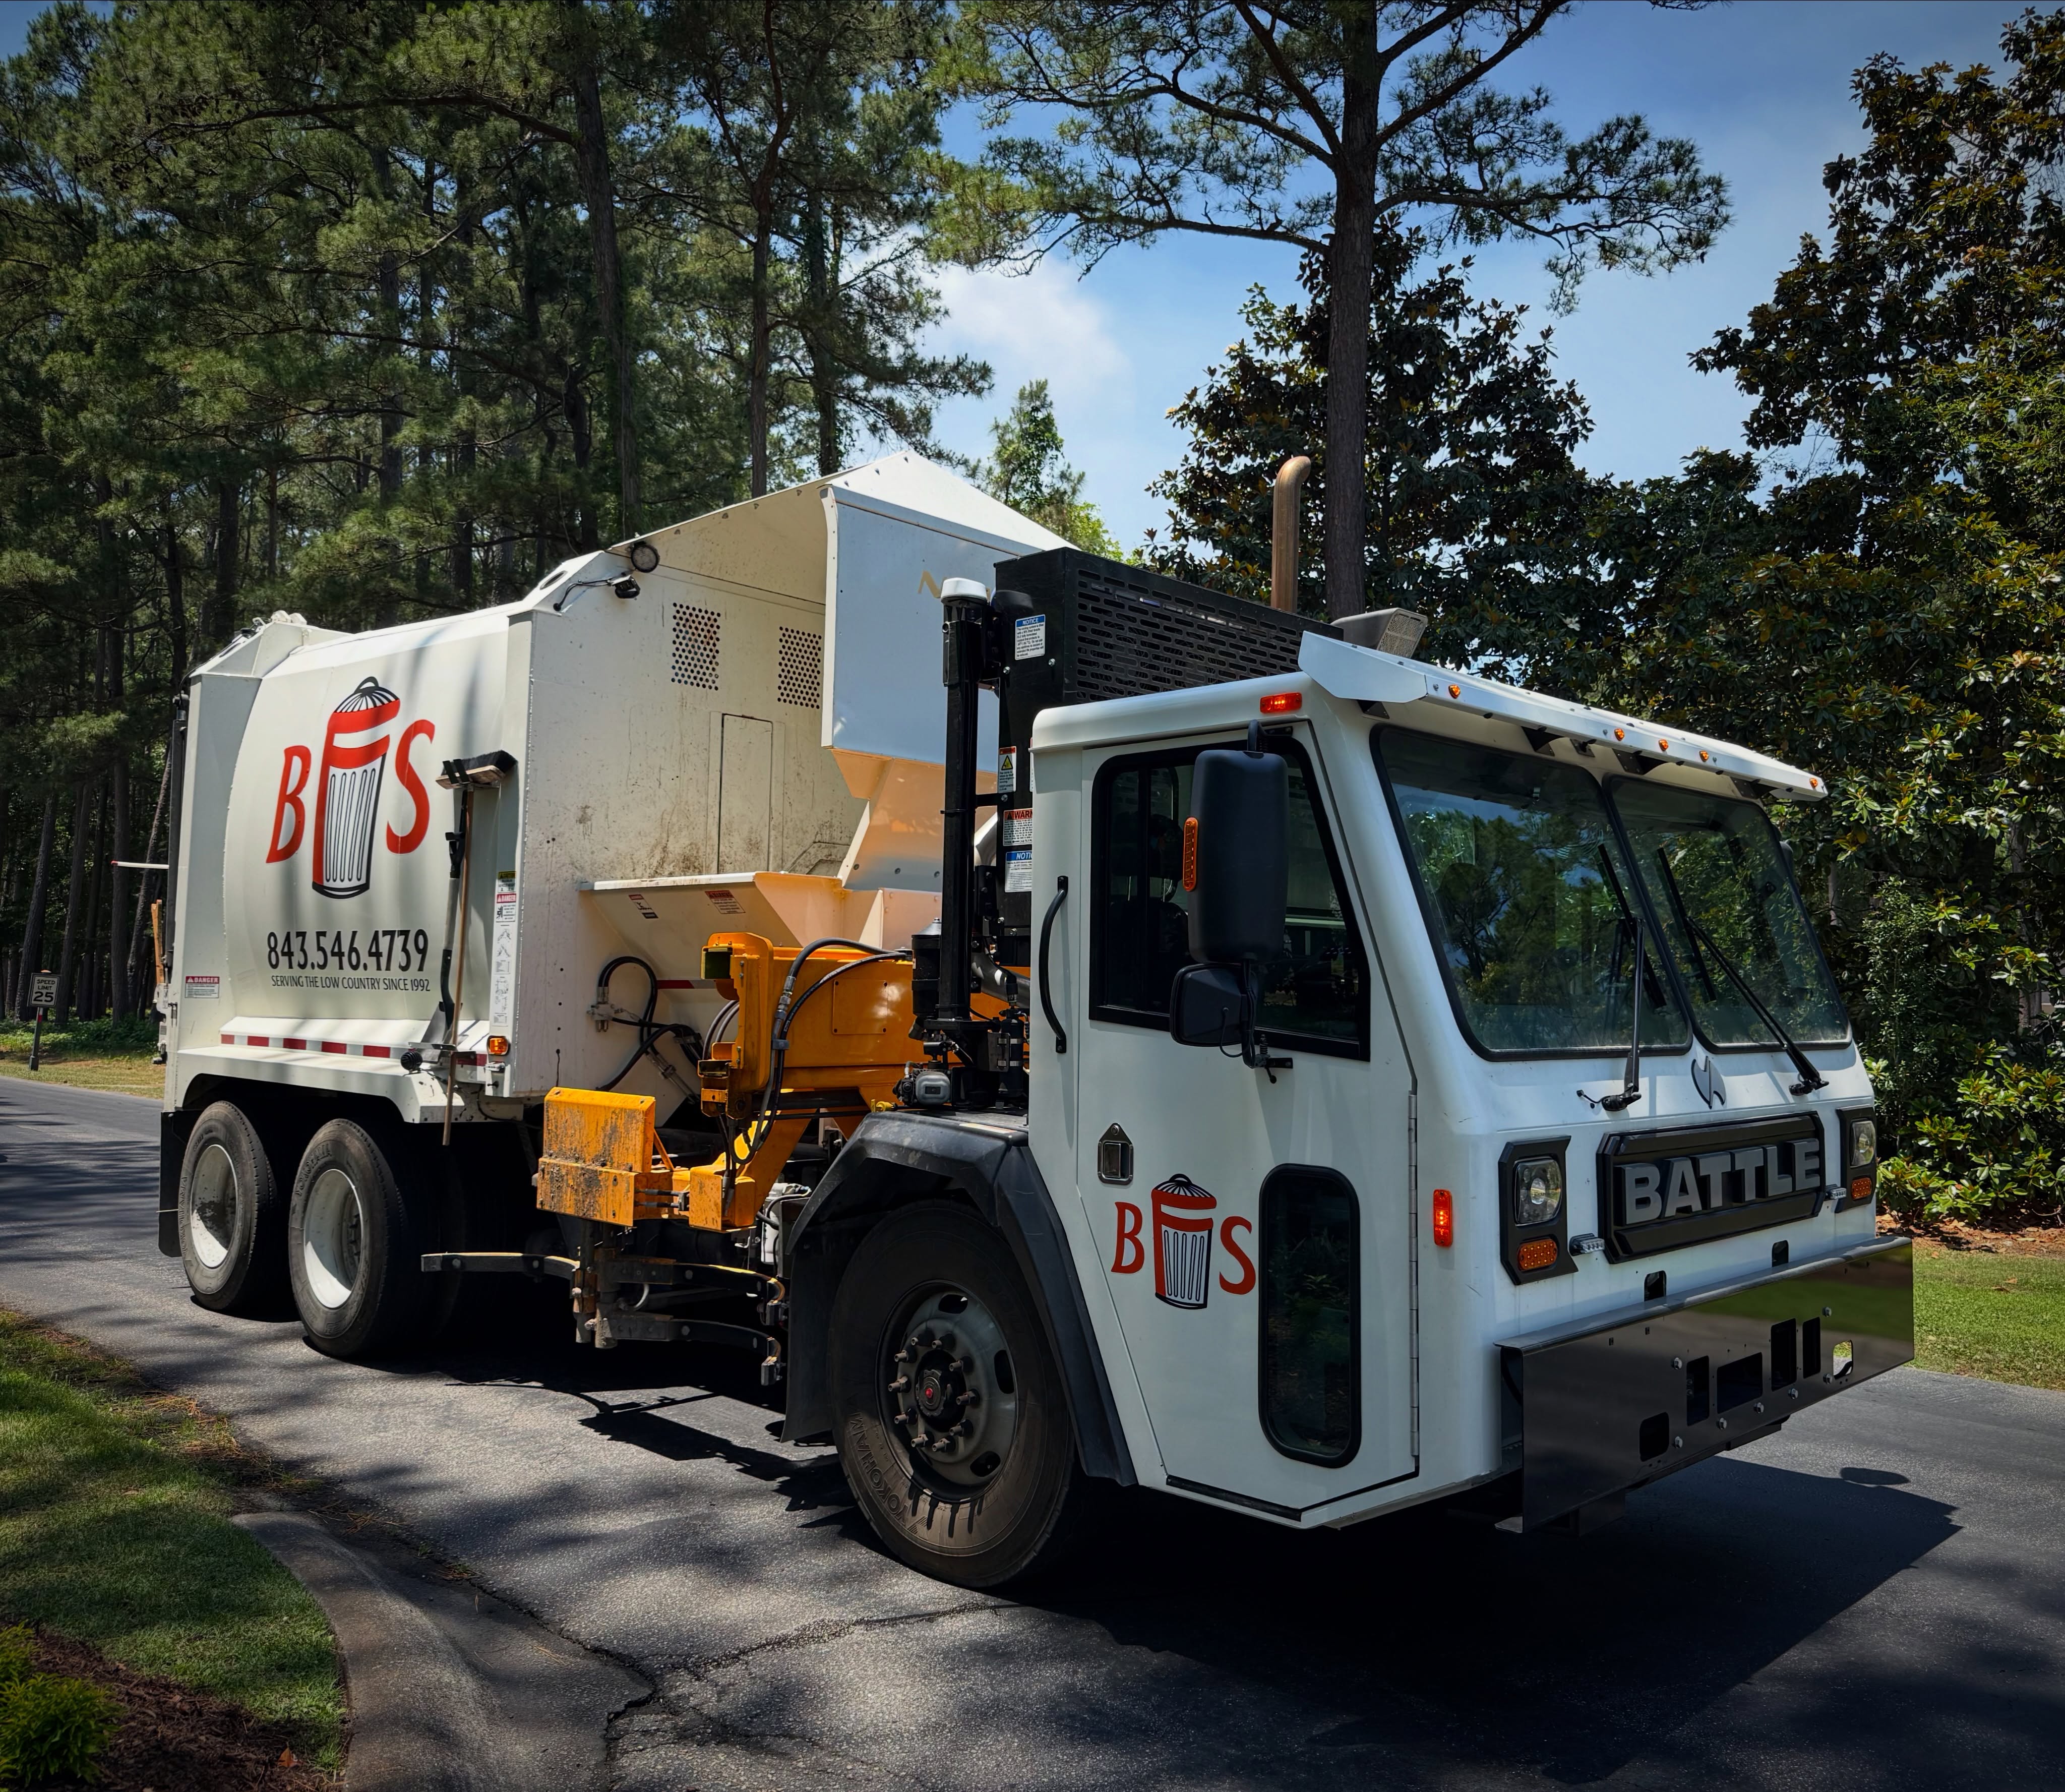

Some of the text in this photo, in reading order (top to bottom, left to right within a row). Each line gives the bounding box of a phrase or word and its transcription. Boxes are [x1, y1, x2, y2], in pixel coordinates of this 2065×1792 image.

[267, 929, 429, 972] 843.546.4739
[33, 991, 53, 1002] 25
[271, 975, 431, 991] SERVING THE LOW COUNTRY SINCE 1992
[1616, 1138, 1820, 1227] BATTLE
